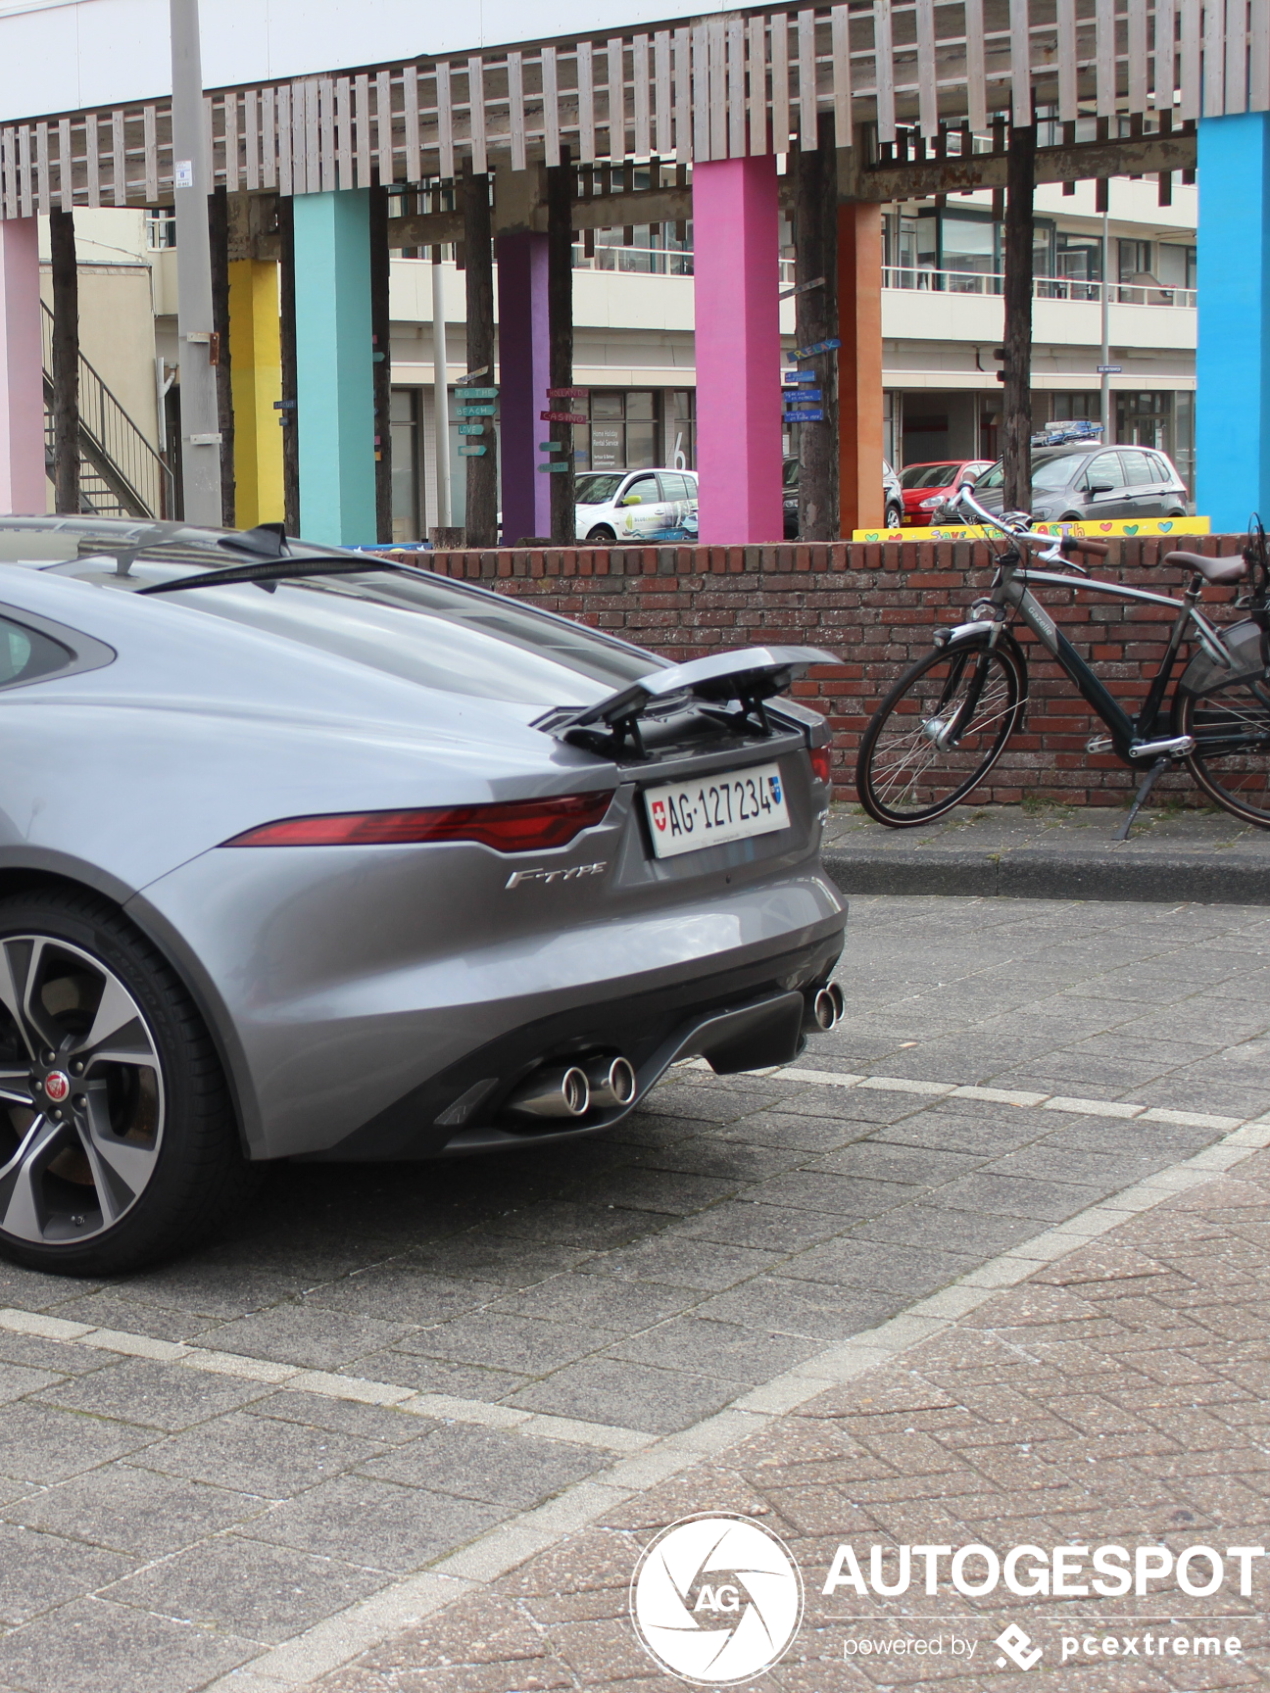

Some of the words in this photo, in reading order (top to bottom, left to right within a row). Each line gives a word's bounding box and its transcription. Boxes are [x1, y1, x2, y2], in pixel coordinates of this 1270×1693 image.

[793, 340, 835, 360] RELAX
[456, 389, 469, 397] TO
[475, 388, 494, 397] THE
[456, 407, 487, 416] BEACH
[543, 412, 584, 423] CASINO
[459, 425, 476, 434] LOVE
[674, 432, 686, 470] 6
[1028, 606, 1054, 636] Gazelle
